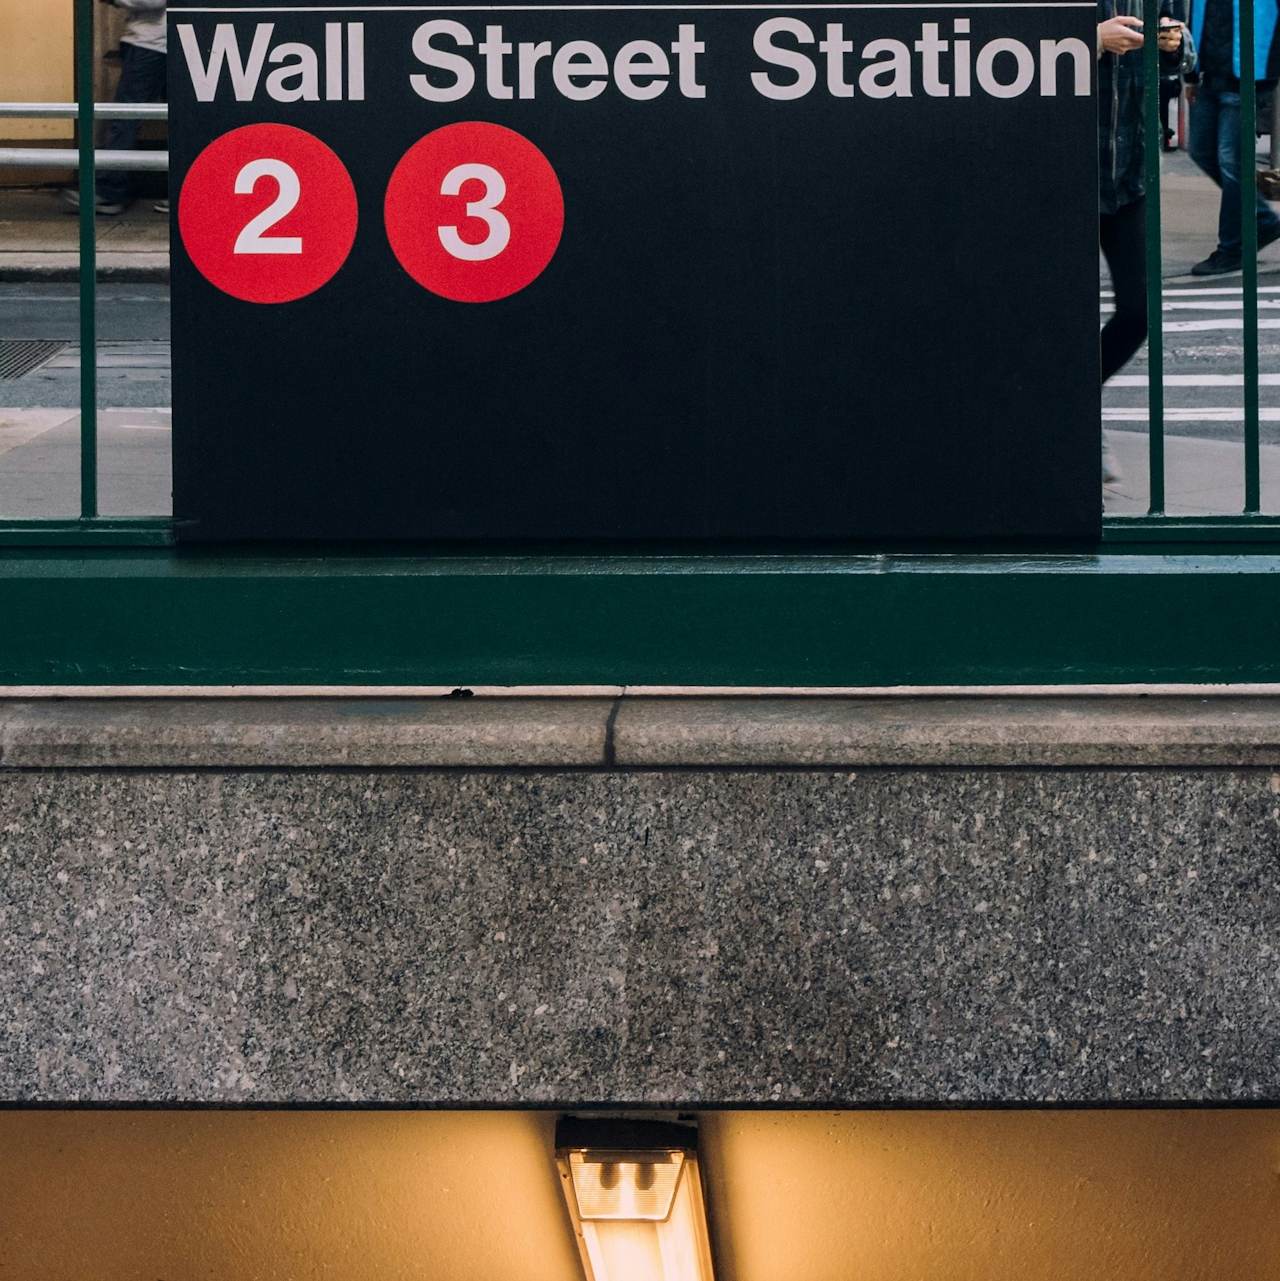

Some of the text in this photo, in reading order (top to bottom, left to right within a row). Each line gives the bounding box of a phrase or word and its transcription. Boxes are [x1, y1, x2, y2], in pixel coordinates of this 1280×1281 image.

[176, 16, 1091, 103] Wall Street Station
[233, 158, 511, 261] 2 3
